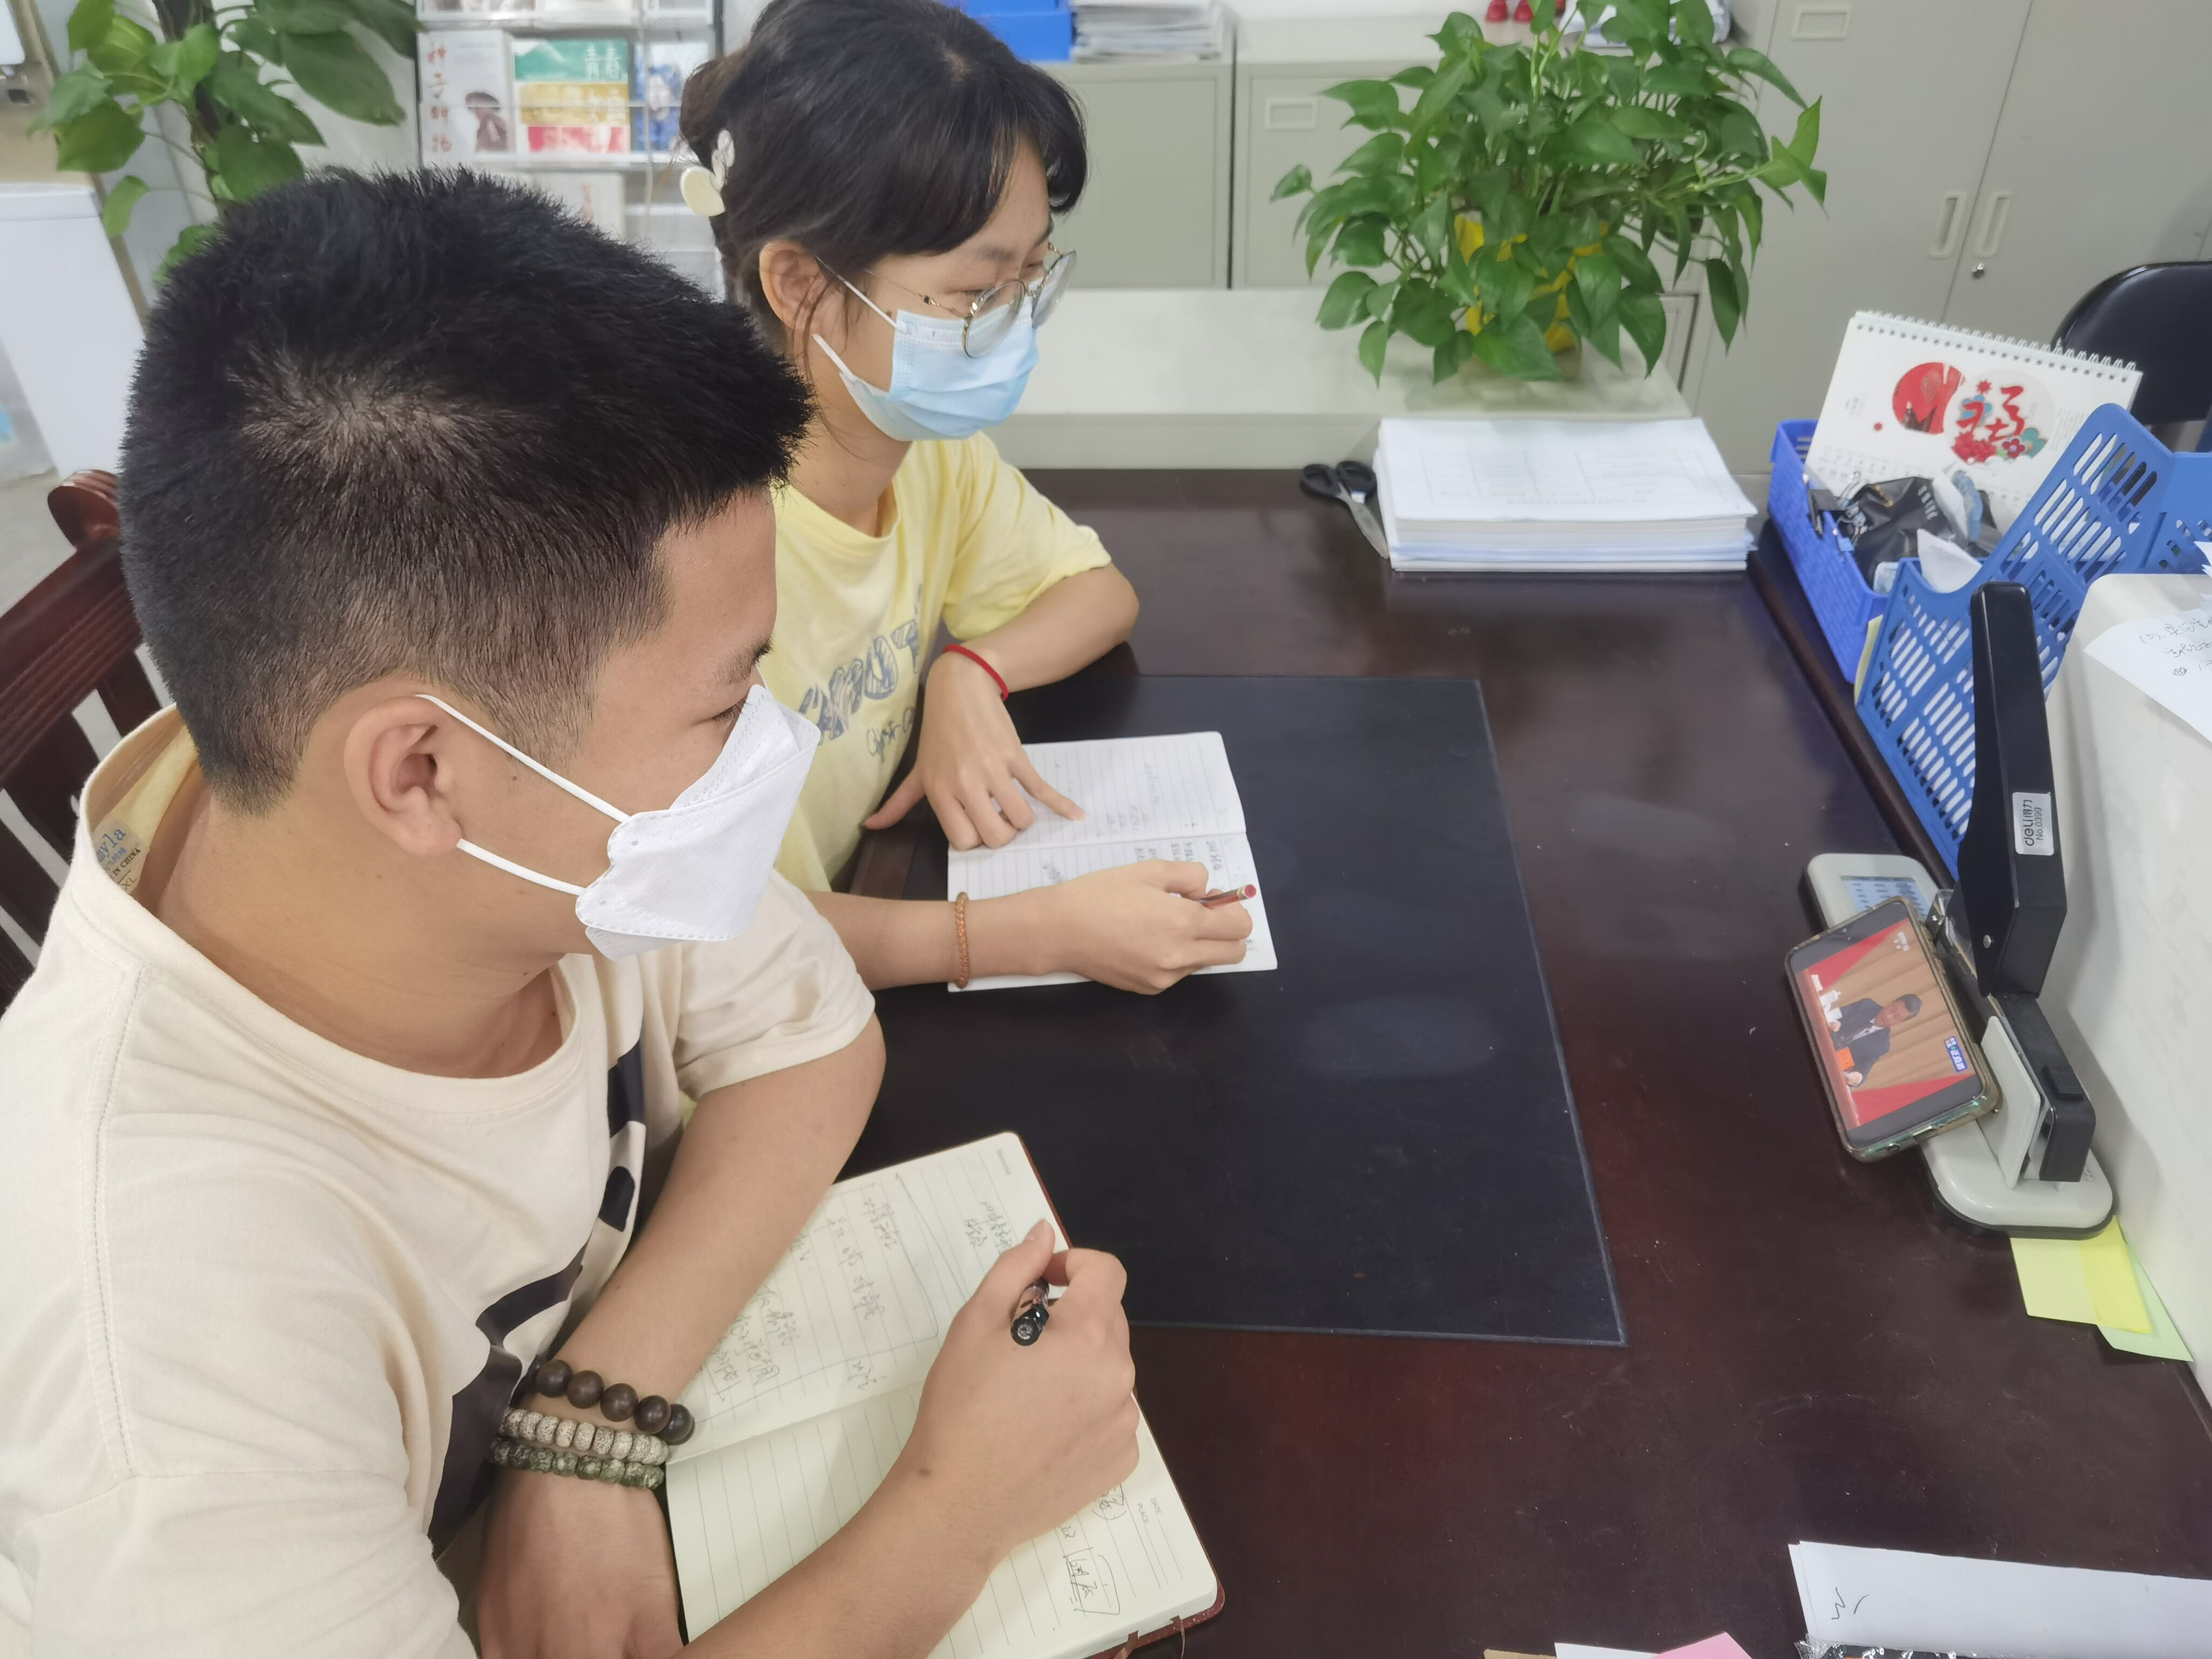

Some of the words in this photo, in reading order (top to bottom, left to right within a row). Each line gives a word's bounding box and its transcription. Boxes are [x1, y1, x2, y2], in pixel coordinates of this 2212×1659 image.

[120, 847, 141, 868] CHINA
[1136, 1502, 1149, 1524] PLACE
[1150, 1497, 1162, 1515] DATE
